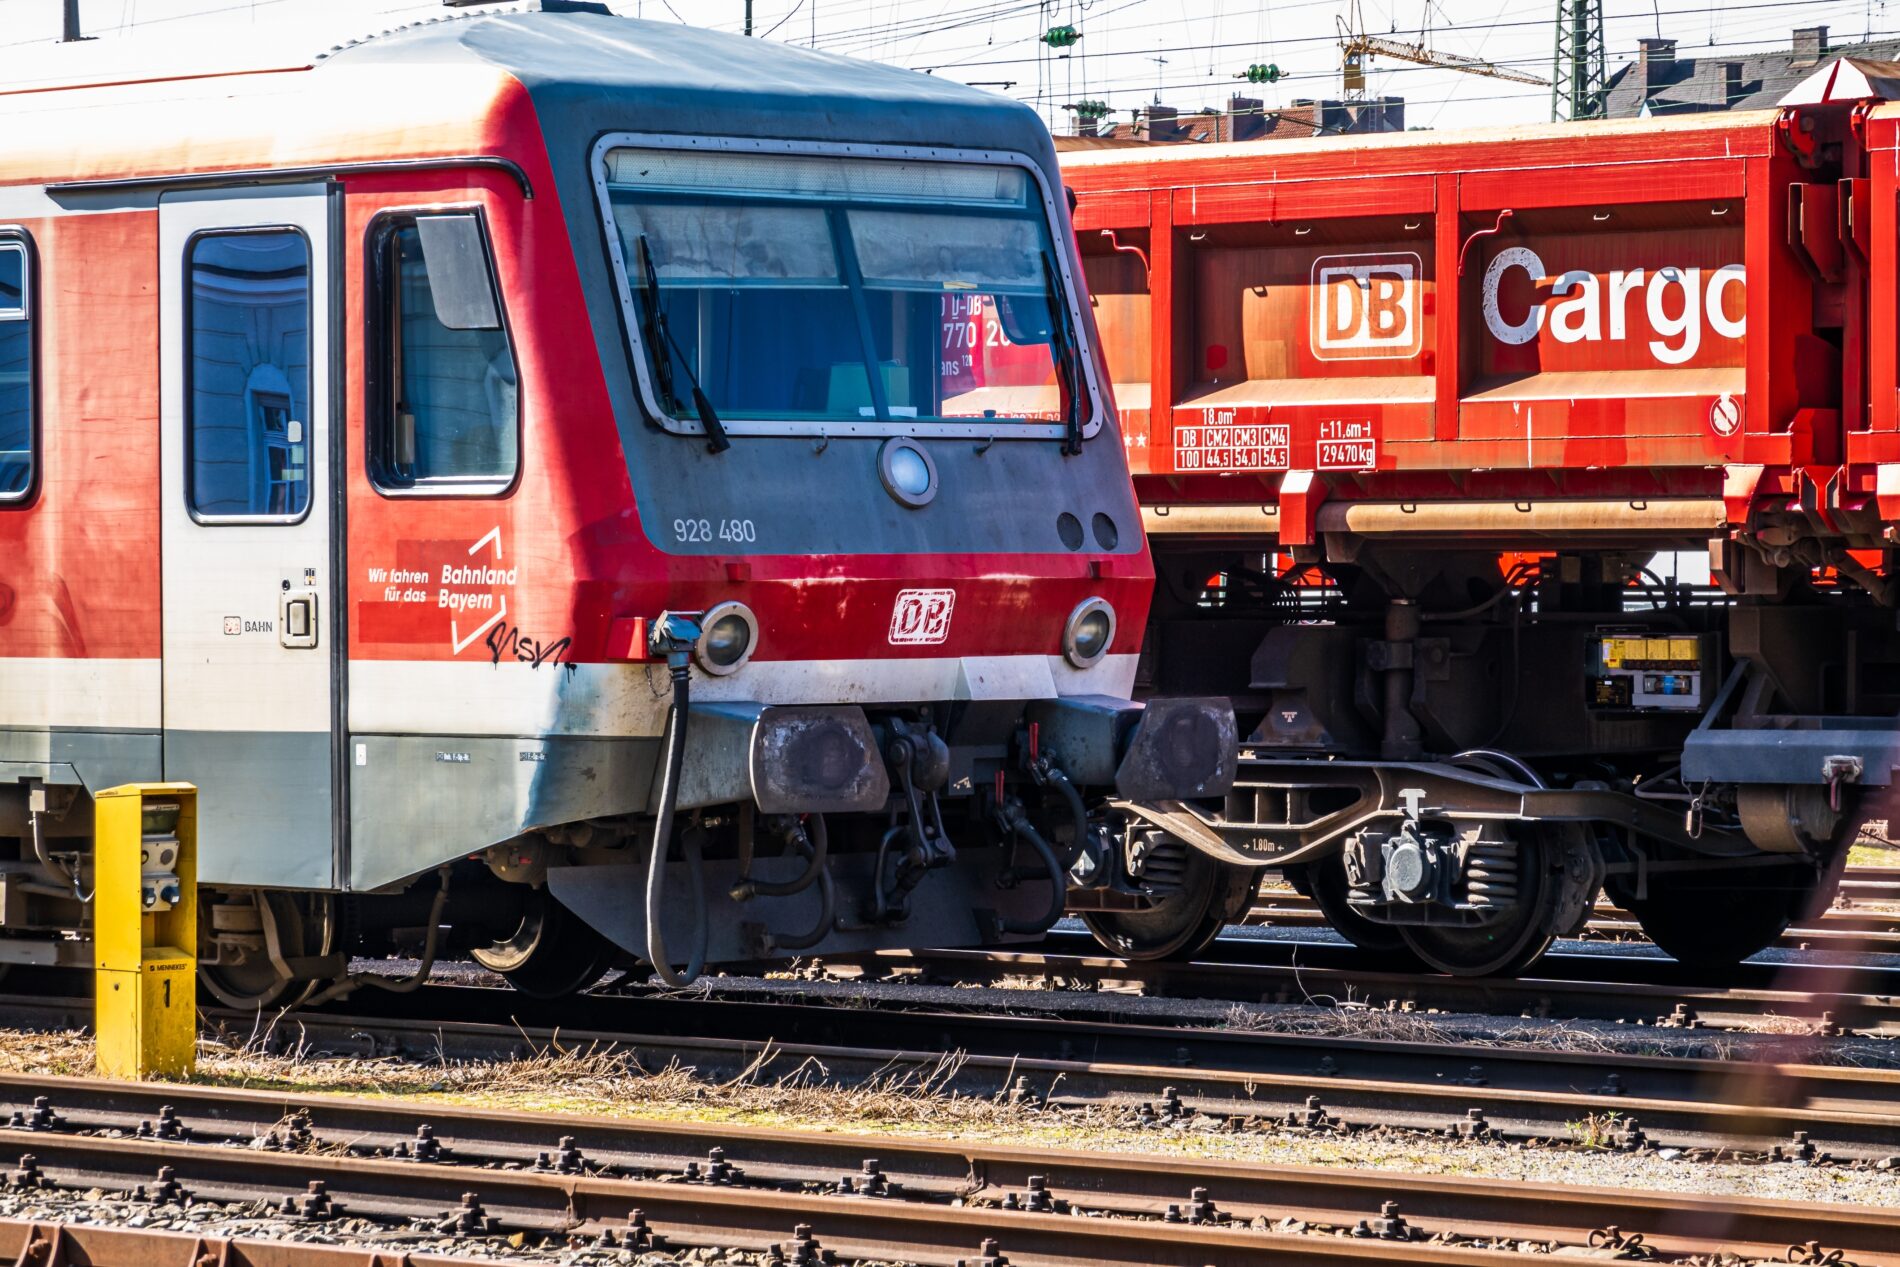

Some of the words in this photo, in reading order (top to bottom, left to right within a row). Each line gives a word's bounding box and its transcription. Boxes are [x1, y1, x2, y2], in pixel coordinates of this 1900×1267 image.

[1326, 271, 1407, 341] DB
[1482, 246, 1747, 364] Cargo
[943, 321, 977, 349] 770
[1182, 430, 1198, 447] DB
[1206, 429, 1230, 447] CM2
[1234, 428, 1258, 446] CM3
[1262, 427, 1286, 446] CM4
[1180, 451, 1200, 469] 100
[673, 518, 713, 543] 928
[718, 518, 757, 543] 480
[368, 567, 388, 583] Wir
[389, 568, 430, 584] fahren
[440, 564, 519, 586] Bahnland
[384, 586, 401, 603] für
[403, 587, 427, 603] das
[437, 588, 494, 613] Bayern
[244, 620, 273, 633] BAHN
[898, 598, 946, 635] DB
[163, 978, 171, 1009] 1
